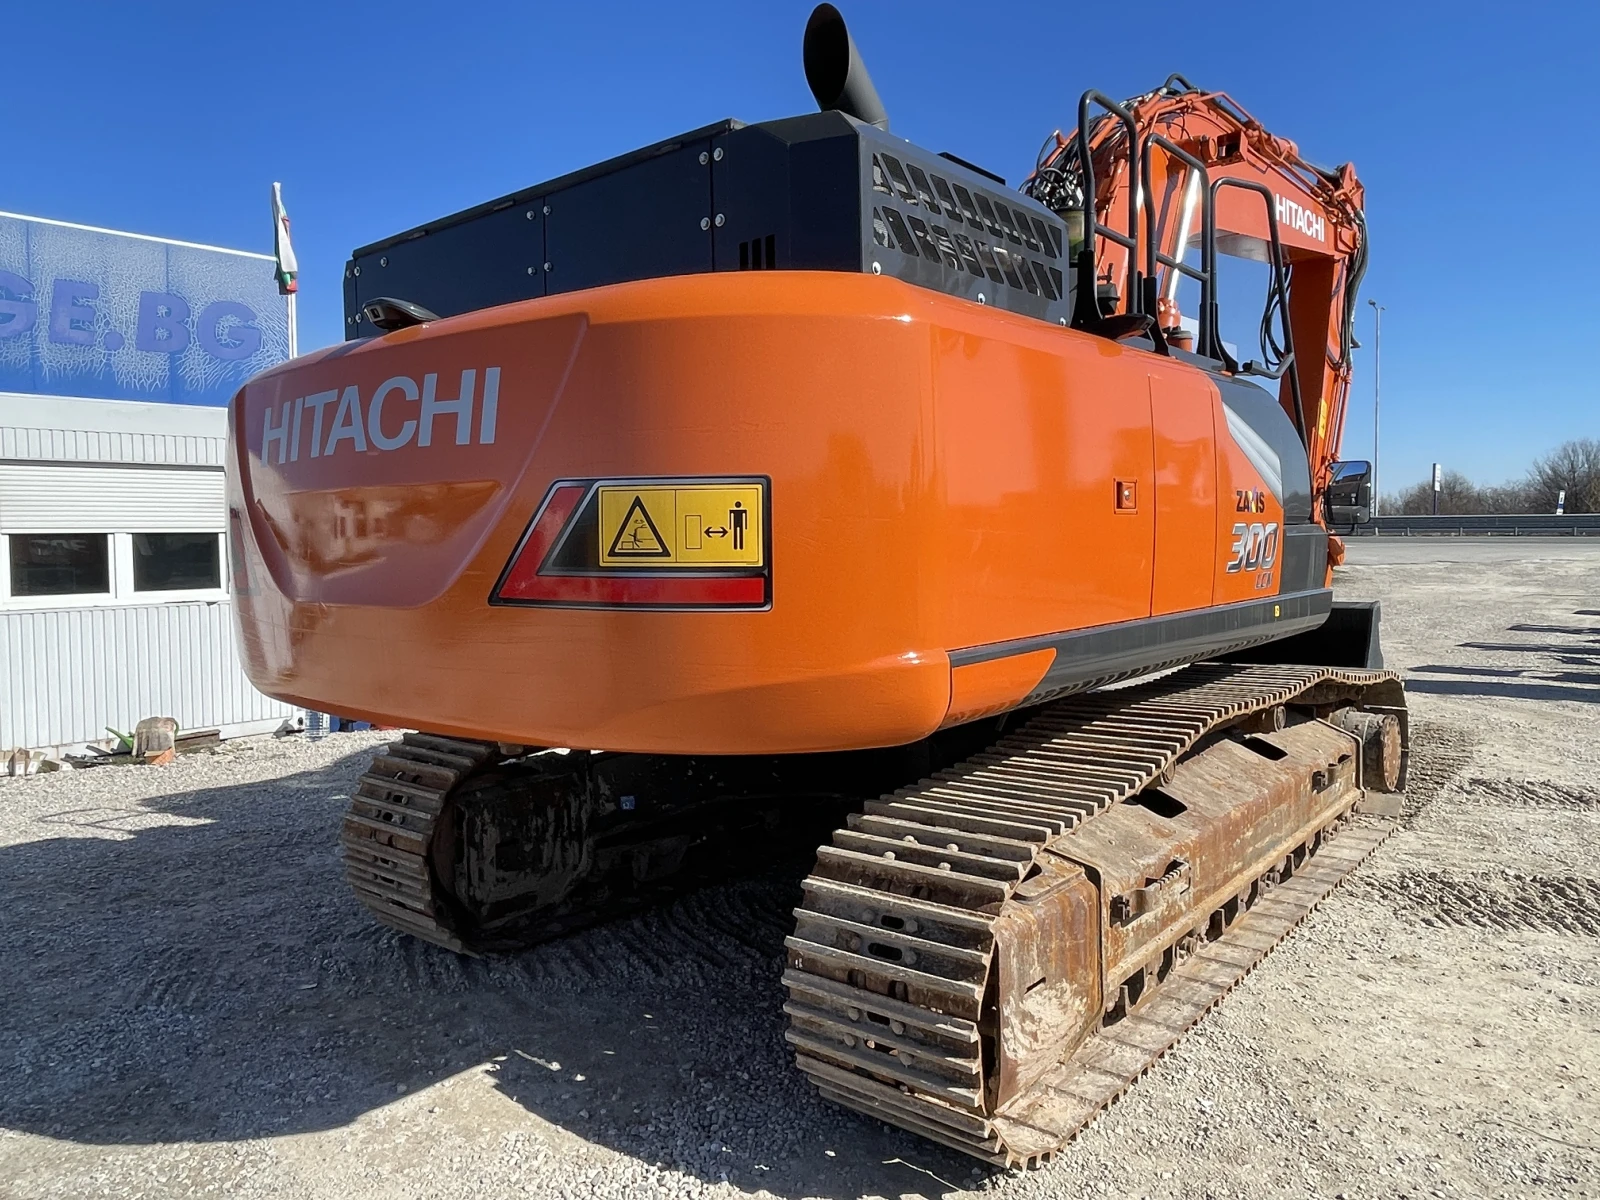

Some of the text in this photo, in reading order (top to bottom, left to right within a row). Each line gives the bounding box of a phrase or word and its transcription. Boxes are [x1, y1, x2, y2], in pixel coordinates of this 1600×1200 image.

[1275, 193, 1324, 242] HITACHI
[261, 367, 501, 467] HITACHI
[1226, 522, 1279, 573] 300
